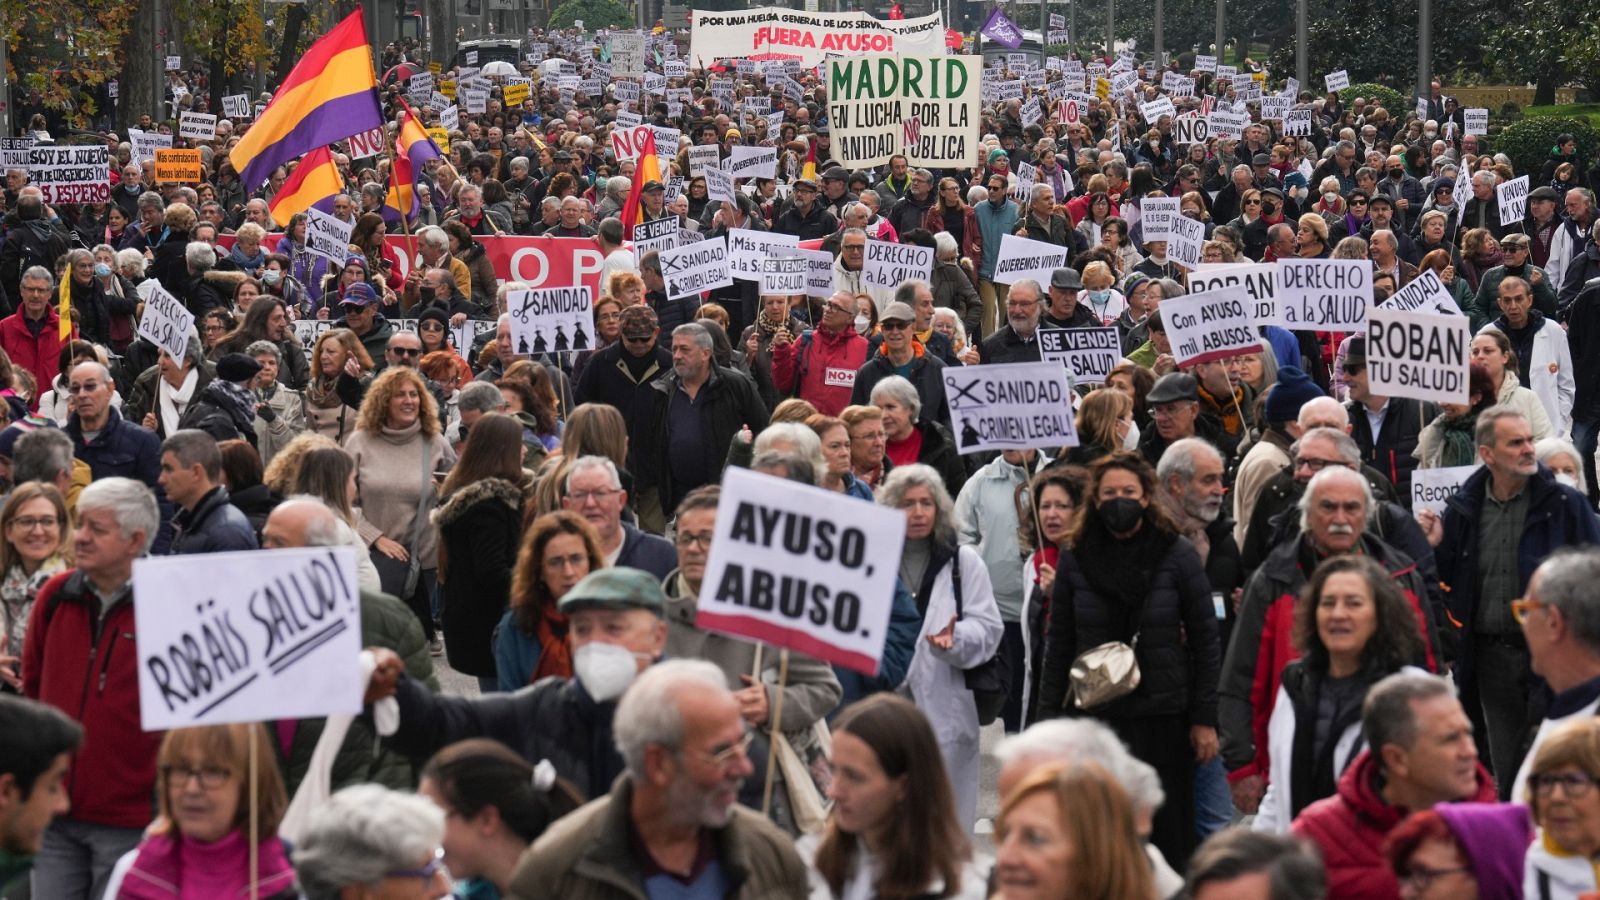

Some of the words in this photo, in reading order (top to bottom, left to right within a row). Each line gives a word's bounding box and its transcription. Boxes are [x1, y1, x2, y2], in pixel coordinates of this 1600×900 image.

[700, 17, 724, 27] ¡POR
[727, 16, 745, 26] UNA
[747, 13, 779, 24] HUELGA
[781, 14, 821, 27] GENERAL
[823, 19, 835, 28] DE
[837, 20, 853, 29] LOS
[753, 26, 816, 49] ¡FUERA
[820, 33, 893, 52] AYUSO!
[832, 58, 968, 101] MADRID
[233, 97, 247, 115] NO
[831, 104, 849, 129] EN
[856, 101, 902, 128] LUCHA
[912, 103, 940, 127] POR
[949, 103, 968, 127] LA
[1058, 101, 1078, 123] NO
[903, 117, 920, 146] NO
[1178, 119, 1208, 142] NO
[3, 140, 11, 149] SE
[13, 139, 34, 149] VENDE
[350, 127, 383, 157] NO
[611, 126, 648, 159] NO
[30, 149, 55, 165] SOY
[57, 150, 72, 165] EL
[74, 147, 109, 165] NUEVO
[157, 168, 173, 178] Menos
[41, 185, 52, 204] S
[55, 183, 110, 204] ESPERO
[1502, 180, 1528, 202] VENDEN
[635, 226, 647, 240] SE
[649, 219, 677, 237] VENDE
[1171, 216, 1199, 241] DERECHO
[731, 236, 756, 252] ¡Más
[868, 244, 928, 266] DERECHO
[1168, 244, 1173, 256] a
[682, 247, 727, 269] SANIDAD,
[731, 260, 737, 270] a
[739, 258, 748, 272] la
[764, 261, 776, 272] SE
[779, 260, 806, 273] VENDE
[808, 262, 832, 272] quear
[997, 258, 1038, 276] ¡QUEREMOS
[1040, 253, 1064, 270] VIVIR!
[678, 273, 704, 292] CRIMEN
[765, 275, 776, 289] TU
[866, 271, 875, 282] a
[878, 266, 888, 283] la
[1284, 265, 1363, 289] DERECHO
[149, 285, 188, 332] DERECHO
[534, 288, 588, 316] SANIDAD
[1285, 305, 1298, 323] a
[1303, 296, 1314, 323] la
[1171, 312, 1196, 330] Con
[1200, 300, 1247, 323] AYUSO,
[142, 323, 150, 332] a
[152, 321, 160, 338] la
[1042, 333, 1062, 351] SE
[1065, 331, 1117, 349] VENDE
[1180, 337, 1198, 357] mil
[1202, 326, 1256, 352] ABUSOS.
[1368, 319, 1463, 366] ROBAN
[1369, 361, 1391, 383] TU
[1398, 364, 1463, 393] SALUD!
[985, 380, 1067, 406] SANIDAD,
[979, 416, 1024, 441] CRIMEN
[1024, 413, 1073, 440] LEGAL!
[1414, 481, 1461, 502] Recort
[729, 501, 874, 578] AYUSO,
[250, 551, 354, 659] SALUD!
[714, 562, 870, 638] ABUSO.
